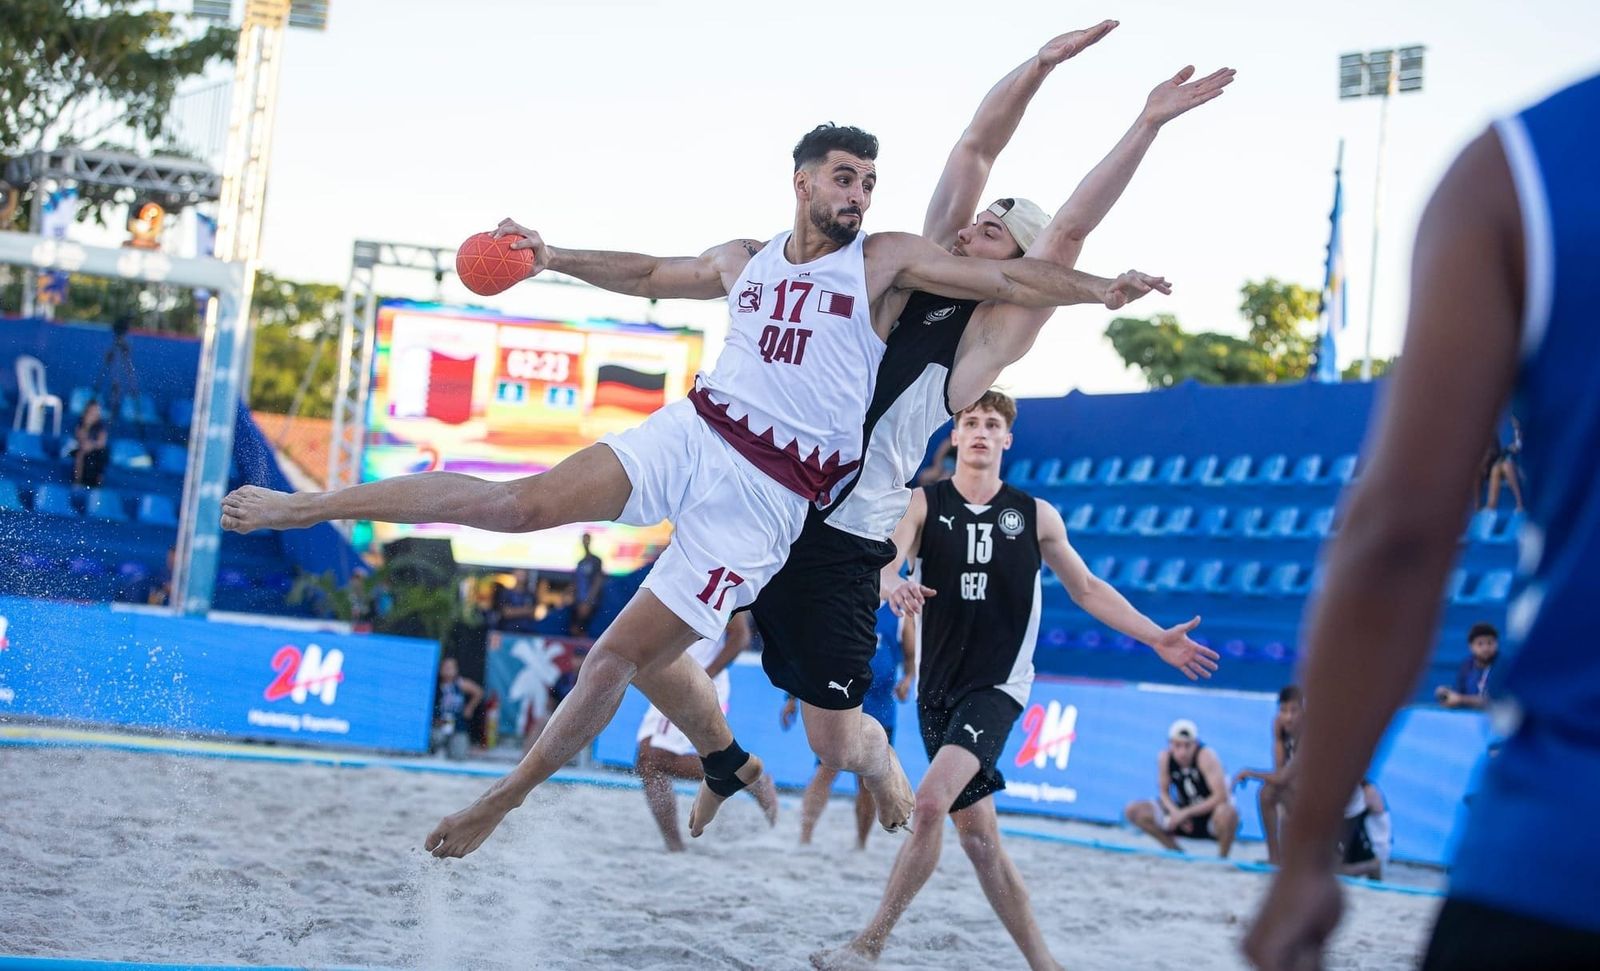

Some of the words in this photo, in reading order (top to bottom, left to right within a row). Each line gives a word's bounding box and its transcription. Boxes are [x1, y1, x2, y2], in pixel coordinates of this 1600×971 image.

[769, 279, 814, 323] 17
[758, 325, 813, 365] QAT
[966, 523, 994, 565] 13
[696, 566, 745, 611] 17
[960, 572, 988, 600] GER
[264, 644, 345, 705] 2M
[1015, 700, 1078, 770] 2M
